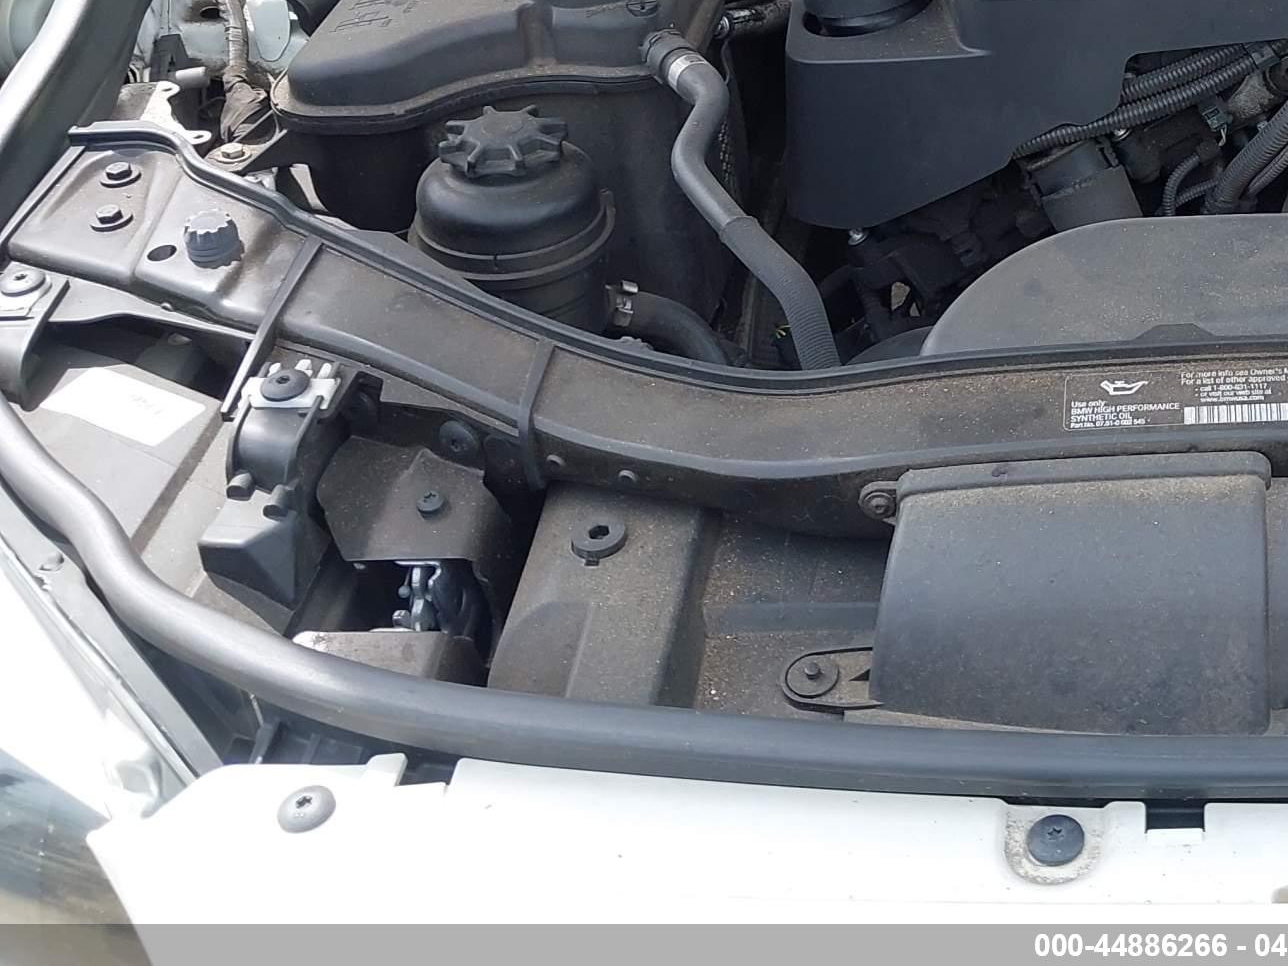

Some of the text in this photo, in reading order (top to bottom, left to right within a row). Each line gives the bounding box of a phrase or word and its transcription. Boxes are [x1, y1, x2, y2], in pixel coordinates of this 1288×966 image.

[1250, 368, 1283, 376] Owner's
[1248, 374, 1286, 383] approved
[1094, 405, 1115, 414] HIGH
[1117, 402, 1180, 412] PERFORMANCE
[1070, 413, 1117, 423] SYNTHETIC
